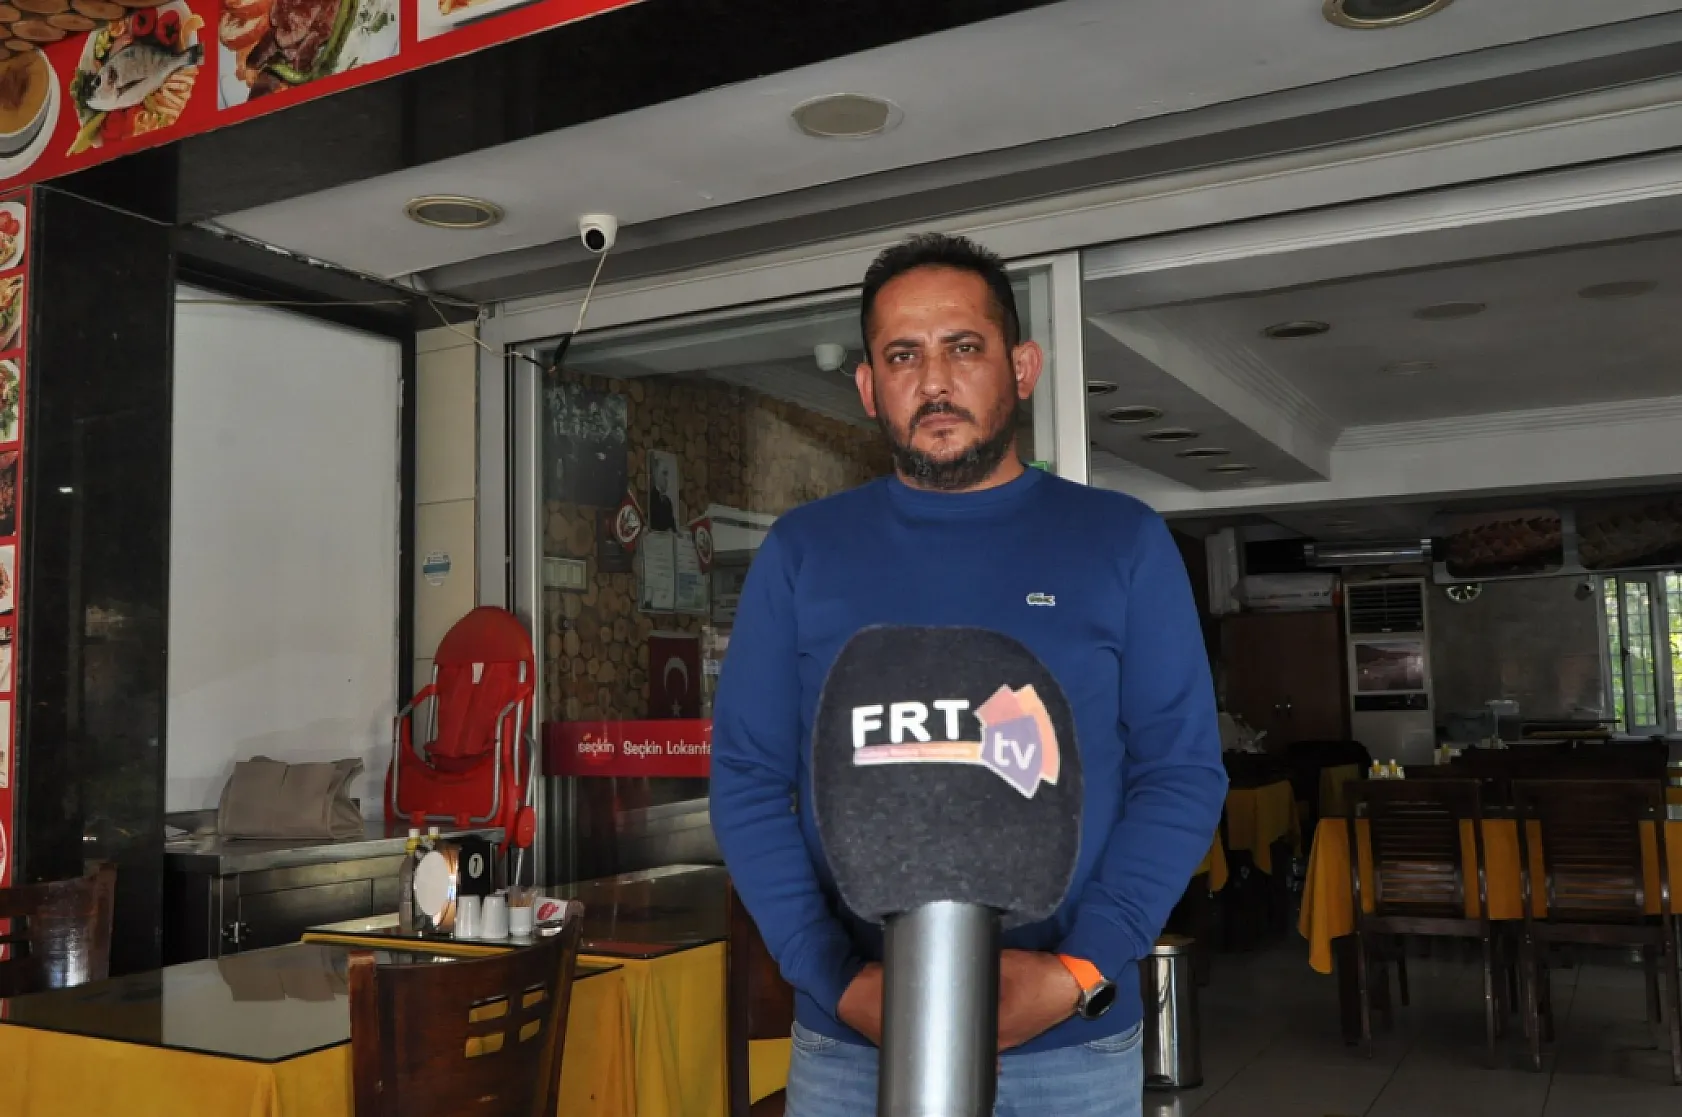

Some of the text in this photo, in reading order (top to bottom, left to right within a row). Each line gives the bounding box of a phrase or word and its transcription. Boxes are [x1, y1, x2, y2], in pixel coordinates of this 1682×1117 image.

[623, 739, 663, 759] Seçkin
[852, 699, 1036, 771] FRT tv
